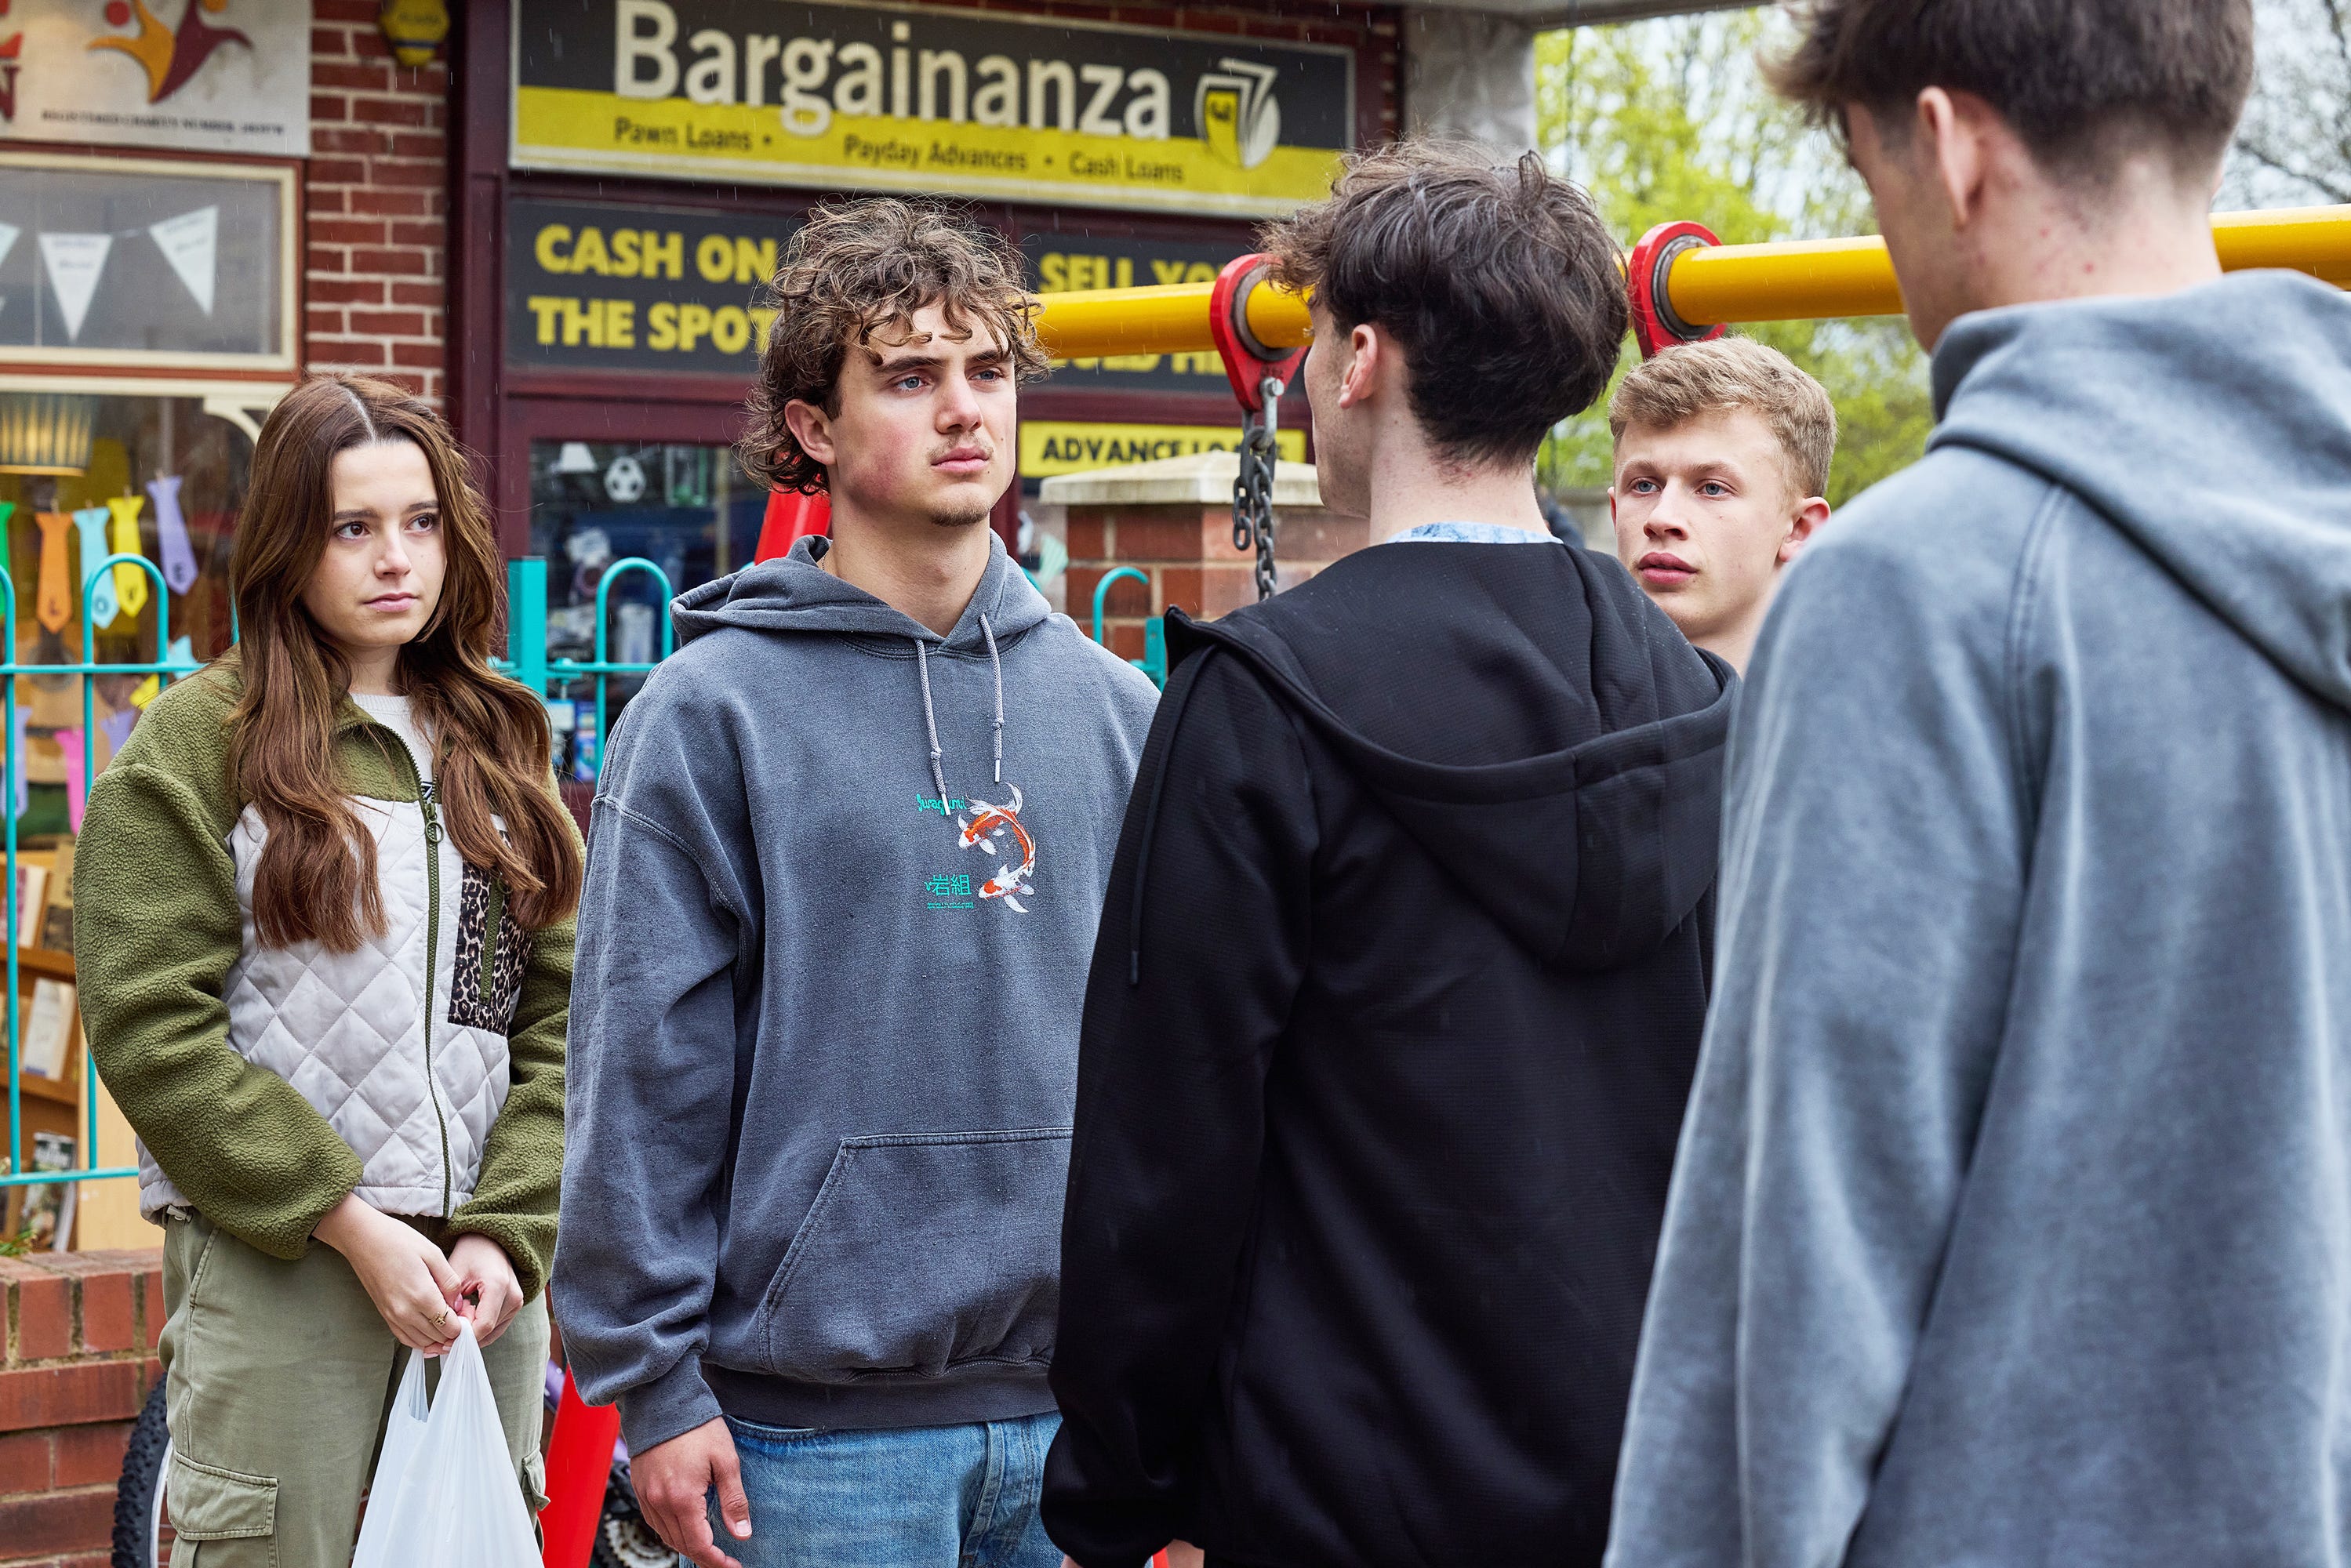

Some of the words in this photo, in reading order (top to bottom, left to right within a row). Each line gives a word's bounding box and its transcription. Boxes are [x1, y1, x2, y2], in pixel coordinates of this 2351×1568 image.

[615, 0, 1171, 140] Bargainanza
[615, 117, 679, 146] Pawn
[685, 121, 753, 151] Loans
[843, 133, 920, 169] Payday
[928, 140, 1028, 173] Advances
[1069, 150, 1119, 176] Cash
[1125, 154, 1183, 182] Loans
[534, 223, 685, 281] CASH
[696, 234, 778, 287] ON
[526, 295, 635, 349] THE
[647, 301, 783, 354] SPOT
[1042, 436, 1182, 462] ADVANCE
